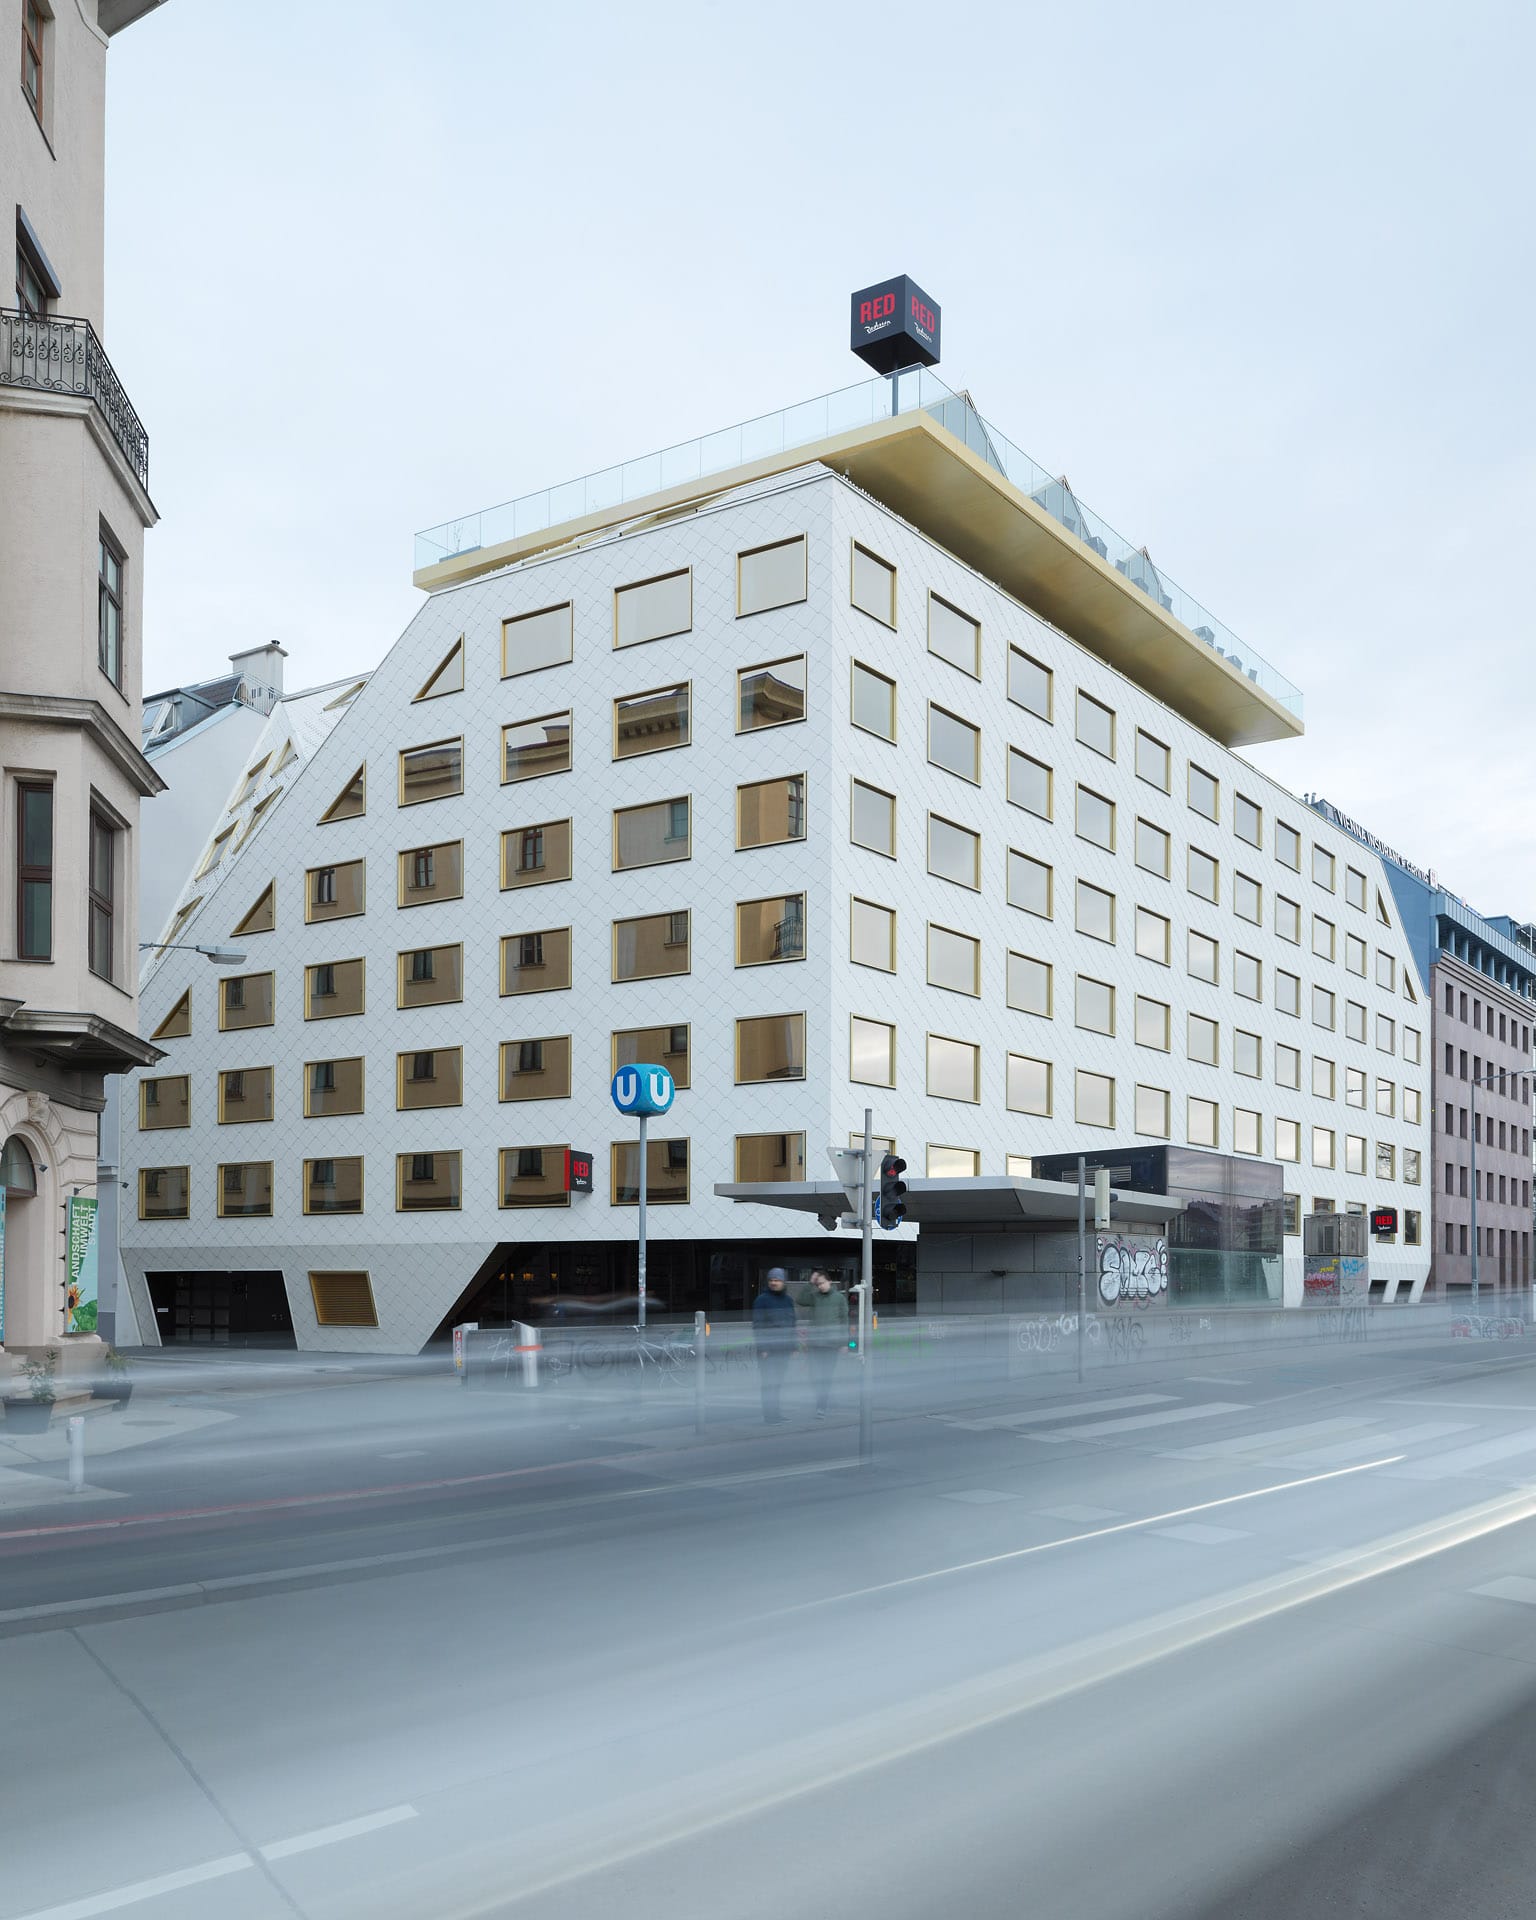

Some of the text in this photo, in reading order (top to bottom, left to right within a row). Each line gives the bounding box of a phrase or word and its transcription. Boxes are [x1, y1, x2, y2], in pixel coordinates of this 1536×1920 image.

[860, 293, 895, 324] RED
[911, 295, 935, 334] RED
[616, 1073, 637, 1106] U
[650, 1073, 671, 1107] U
[573, 1160, 589, 1177] RED
[80, 1204, 89, 1258] UMWELT
[88, 1205, 97, 1245] STADT
[1375, 1215, 1393, 1225] RED
[72, 1203, 80, 1285] LANDSCHAFT
